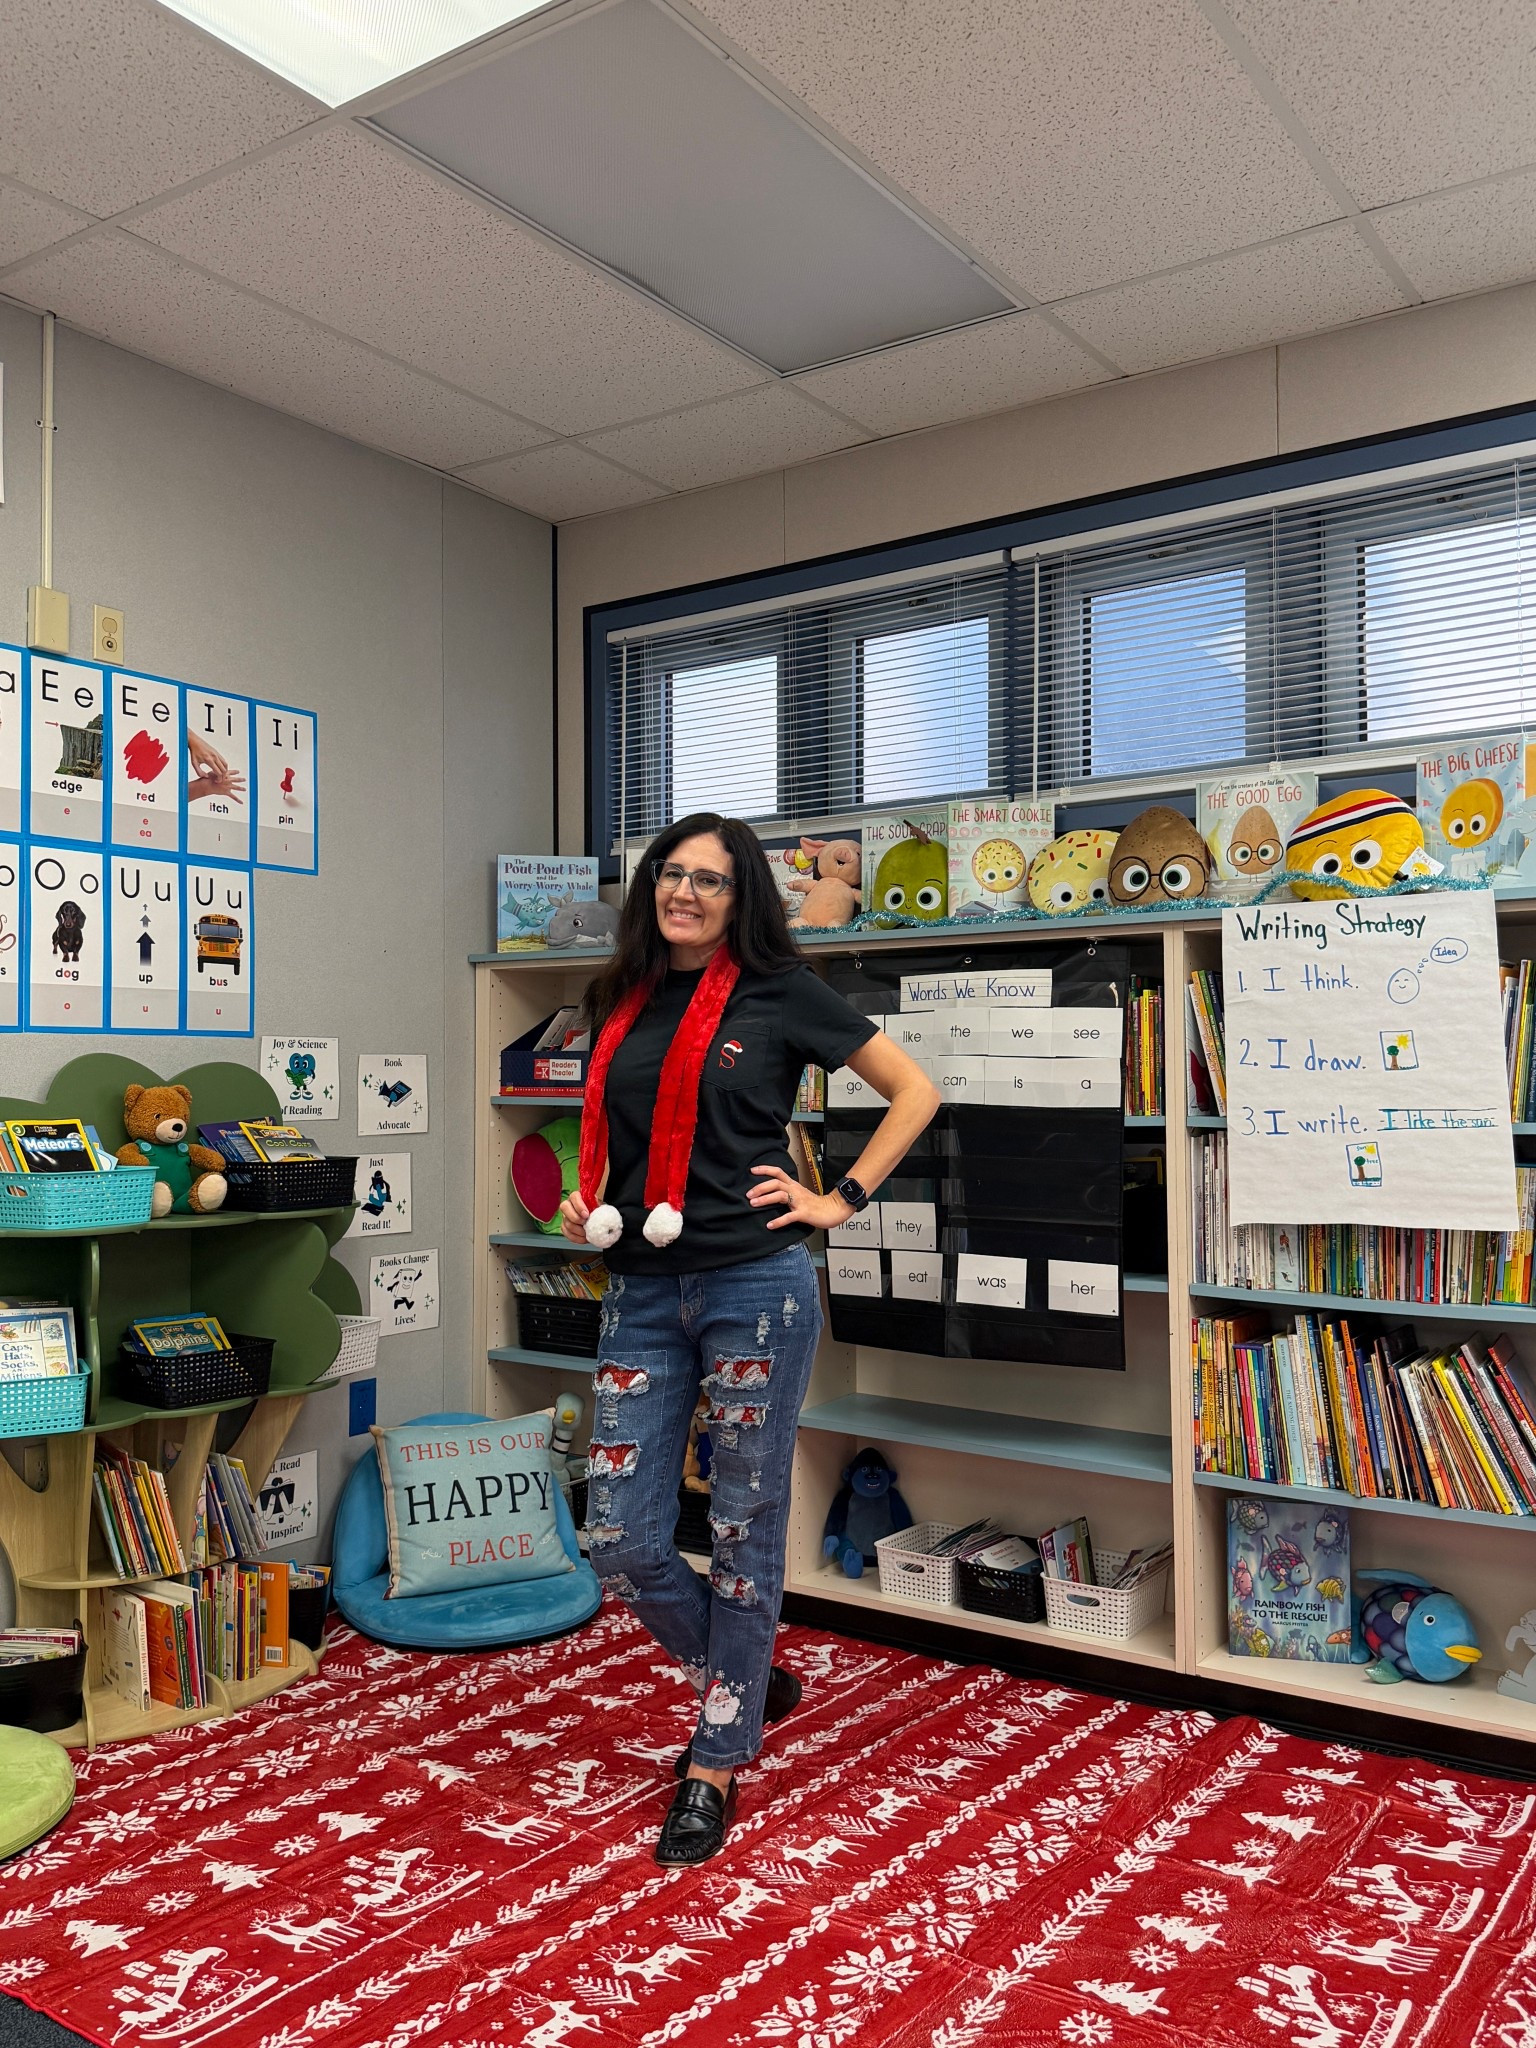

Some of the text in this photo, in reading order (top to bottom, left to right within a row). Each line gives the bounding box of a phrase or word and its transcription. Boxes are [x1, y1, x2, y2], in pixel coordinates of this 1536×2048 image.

[1422, 742, 1520, 779] THE BIG CHEESE
[52, 779, 83, 794] edge
[136, 790, 155, 803] red
[1207, 786, 1302, 810] THE GOOD EGG
[64, 807, 71, 815] e
[209, 802, 229, 815] itch
[952, 807, 1052, 823] THE SMART COOKIE
[142, 817, 149, 826] e
[279, 814, 294, 826] pin
[140, 829, 152, 838] ea
[866, 821, 946, 841] THE SOU GRAP
[504, 862, 592, 876] Pout-Pout Fish
[504, 880, 594, 892] Worry-Worry Whale
[1236, 902, 1428, 950] Writing Strategy
[1434, 946, 1459, 958] Idea
[55, 967, 79, 981] dog
[139, 972, 153, 985] up
[1238, 964, 1360, 993] 1. I think.
[209, 976, 228, 987] bus
[908, 977, 1037, 1002] Words We Know
[64, 1002, 71, 1010] o
[142, 1005, 148, 1013] u
[902, 1024, 1101, 1044] like the we see
[273, 1039, 328, 1050] Joy & Science
[719, 1042, 735, 1069] S
[1239, 1038, 1367, 1071] 2. I draw.
[384, 1058, 403, 1068] Book
[551, 1061, 578, 1069] Reader's
[541, 1067, 549, 1079] K
[846, 1075, 1092, 1095] go can is a
[289, 1105, 323, 1116] Reading
[377, 1120, 411, 1130] Advocate
[1241, 1105, 1369, 1136] 3. I write.
[1383, 1108, 1399, 1130] I
[1407, 1110, 1435, 1129] like
[1441, 1110, 1468, 1128] the
[24, 1138, 80, 1151] Meteors
[266, 1139, 312, 1148] Cool Cars
[369, 1157, 384, 1168] Just
[362, 1220, 391, 1231] Read It!
[895, 1219, 922, 1237] they
[379, 1253, 430, 1268] Books Change
[838, 1266, 1096, 1296] down eat was her
[395, 1314, 416, 1326] Lives!
[153, 1333, 209, 1350] Dolphins
[1, 1344, 33, 1353] Caps,
[4, 1352, 33, 1361] Hats,
[0, 1360, 39, 1370] Socks,
[0, 1372, 43, 1381] Mittens
[400, 1432, 545, 1463] THIS IS OUR
[280, 1458, 301, 1472] Read
[404, 1471, 549, 1526] HAPPY
[271, 1522, 304, 1541] Inspire!
[448, 1533, 535, 1566] PLACE
[1254, 1599, 1326, 1612] RAINBOW FISH
[1252, 1609, 1328, 1623] TO THE RESCUE!
